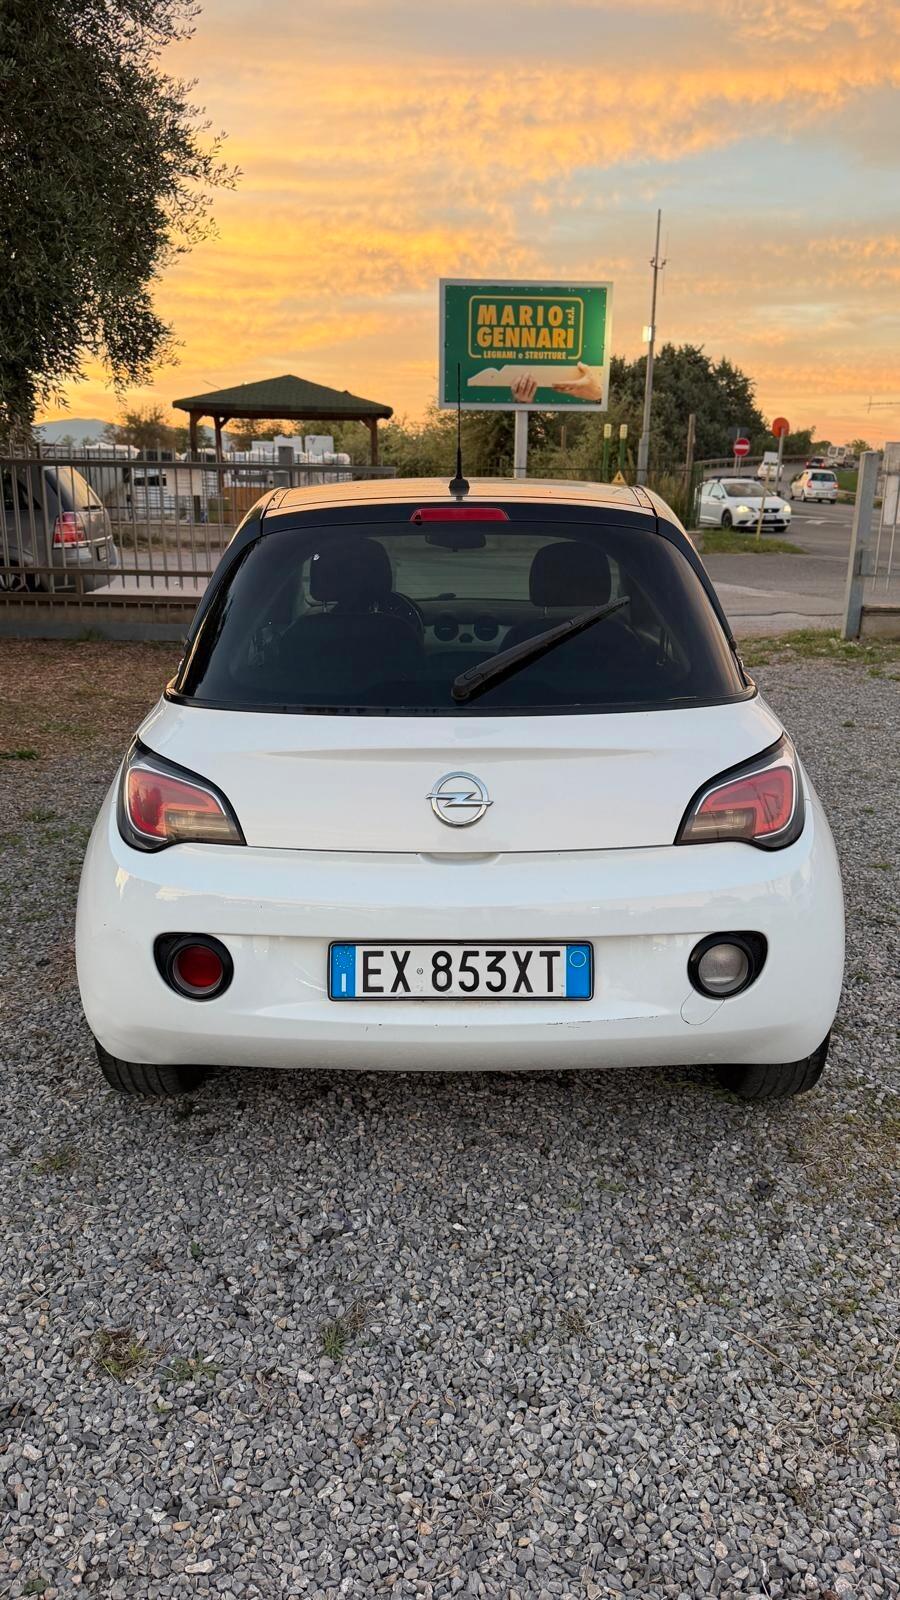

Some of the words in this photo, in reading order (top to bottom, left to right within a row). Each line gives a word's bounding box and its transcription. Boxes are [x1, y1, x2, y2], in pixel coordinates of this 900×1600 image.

[477, 304, 563, 326] MARIO
[477, 327, 574, 348] GENNARI
[484, 351, 516, 359] LEGNAMI
